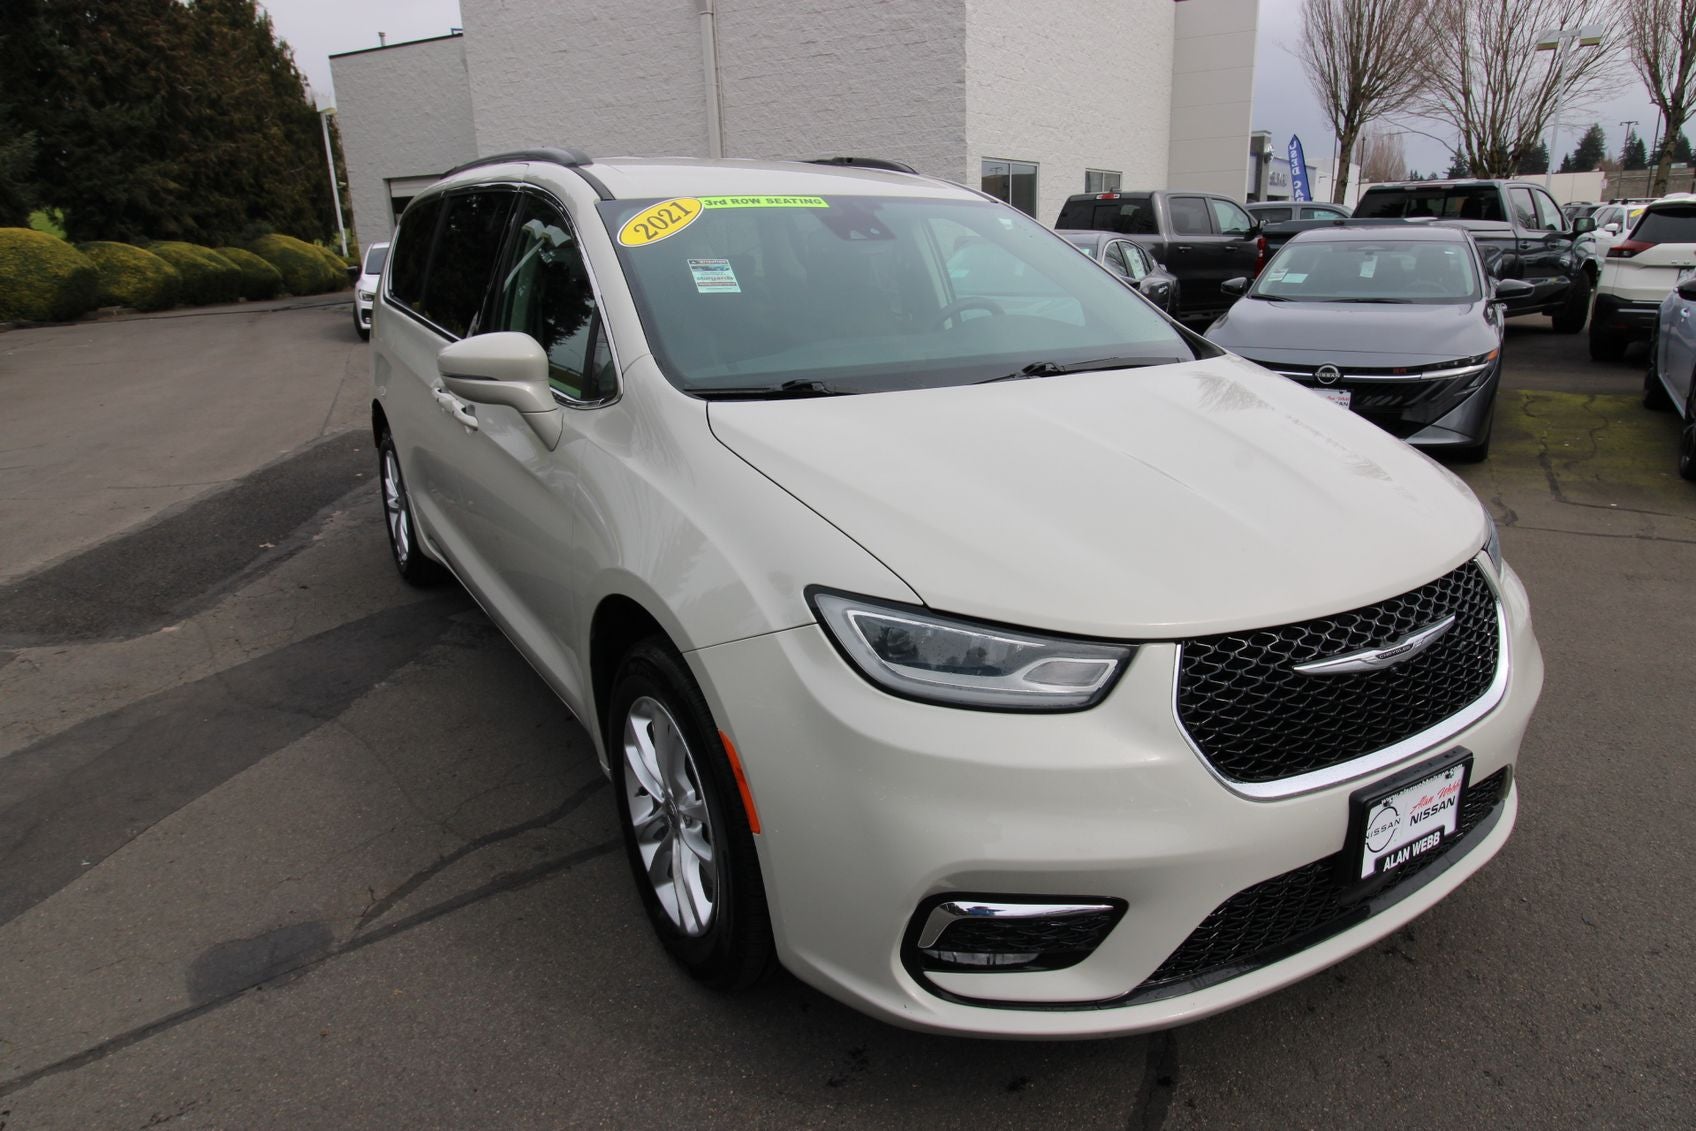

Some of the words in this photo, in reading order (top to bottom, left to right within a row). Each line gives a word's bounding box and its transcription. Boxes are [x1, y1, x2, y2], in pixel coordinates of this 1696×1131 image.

[704, 197, 727, 206] 3rd
[730, 197, 762, 205] ROW
[767, 197, 823, 206] SEATING
[633, 201, 693, 240] 2021
[1409, 796, 1456, 826] NISSAN
[1410, 795, 1434, 815] Alan
[1364, 818, 1401, 839] NISSAN
[1383, 847, 1410, 872] ALAN
[1412, 832, 1440, 856] WEBB
